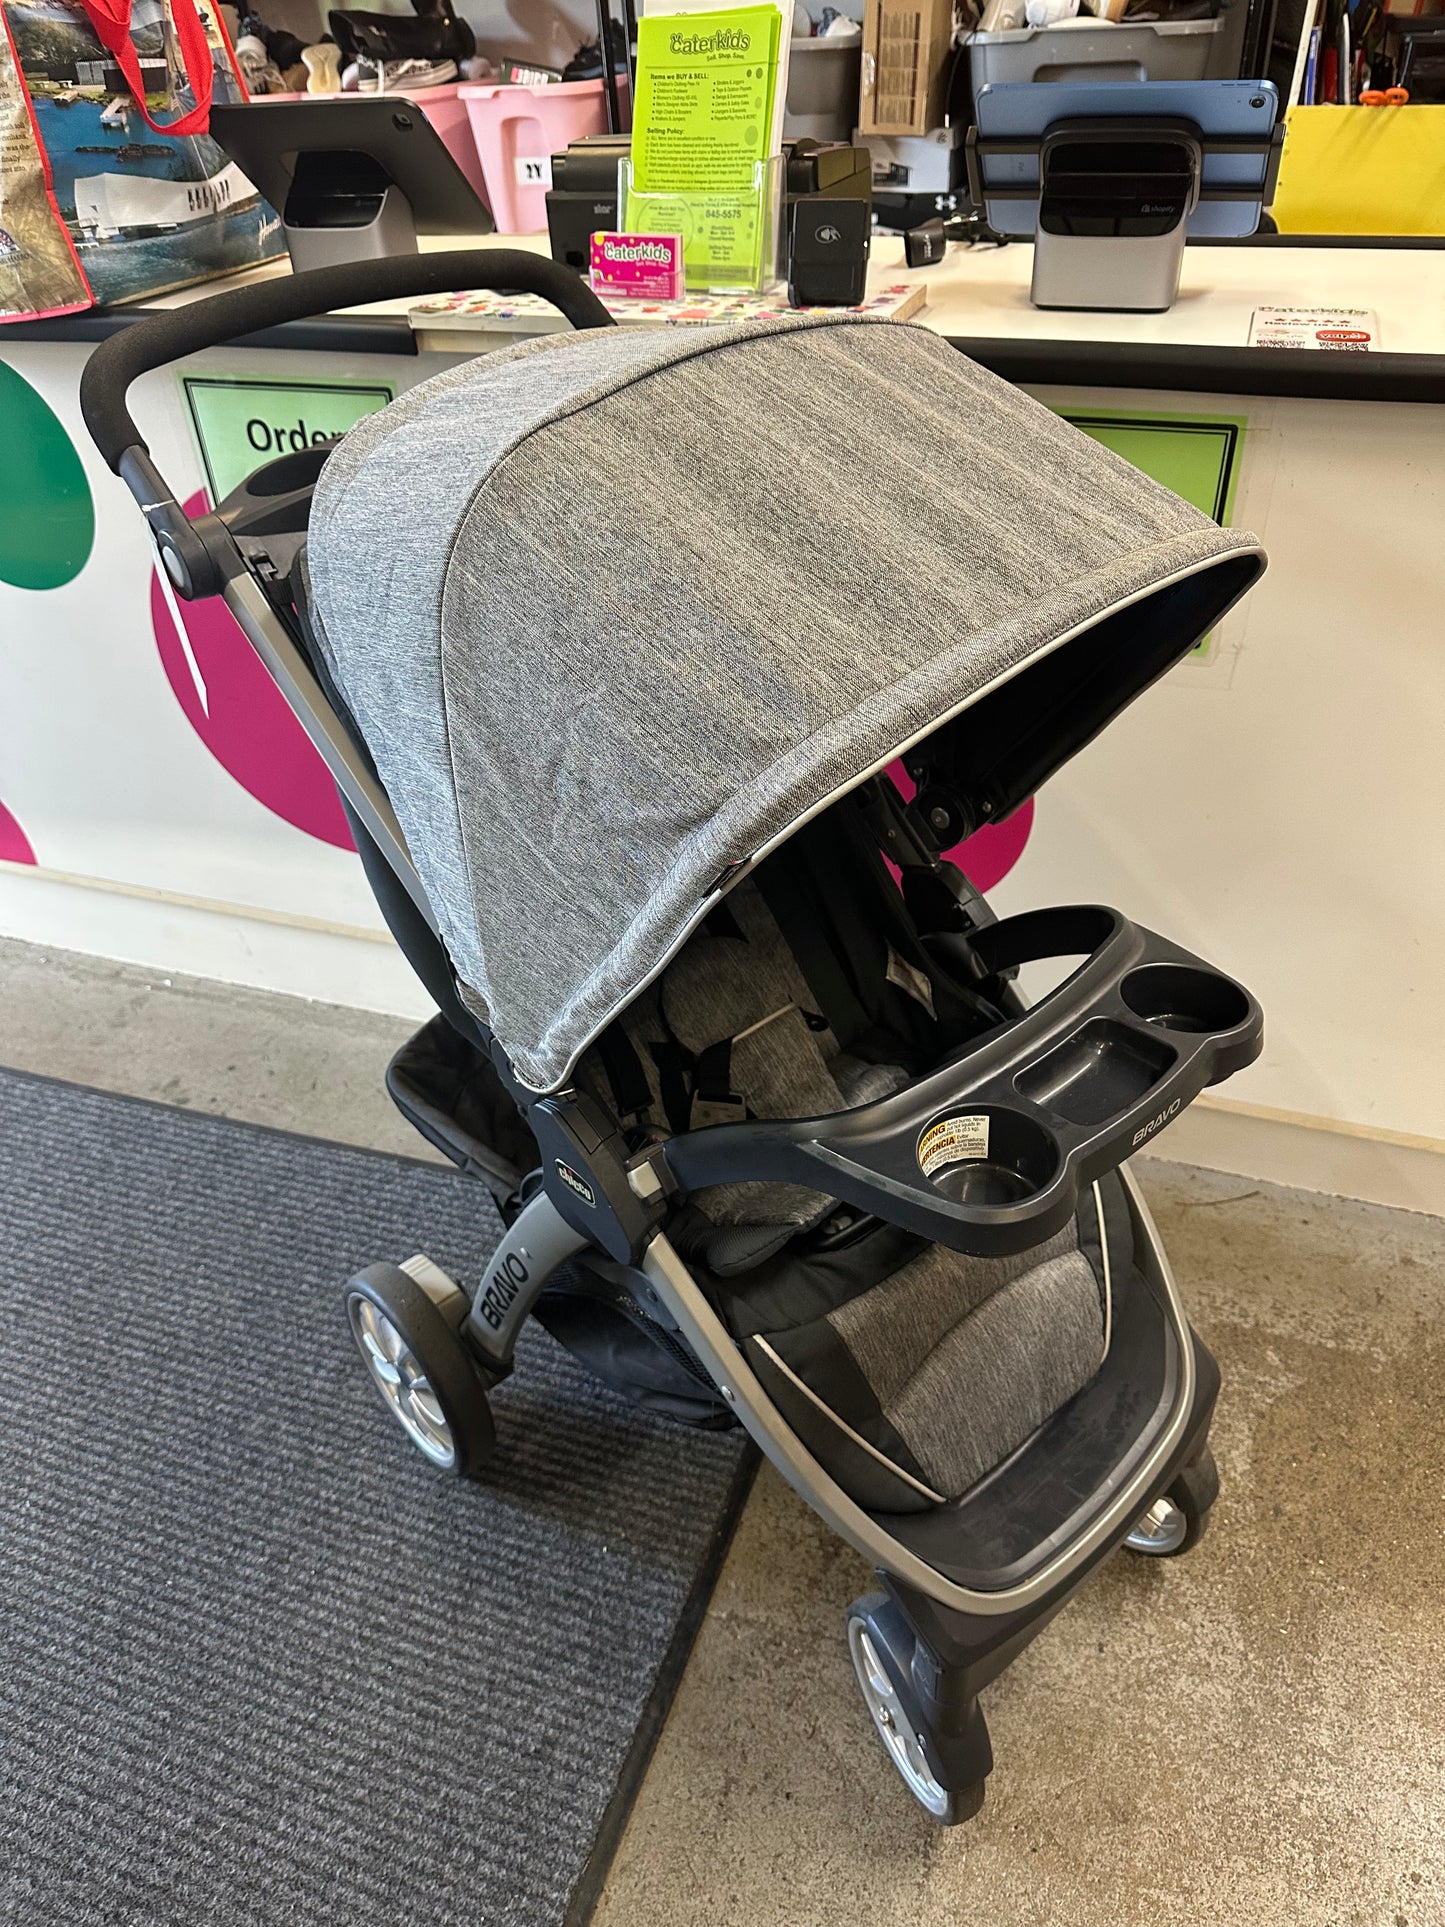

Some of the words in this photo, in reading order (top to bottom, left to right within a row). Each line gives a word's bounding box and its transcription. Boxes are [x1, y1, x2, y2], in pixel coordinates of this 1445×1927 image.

[670, 28, 751, 55] Caterkids
[646, 127, 666, 135] Selling
[604, 241, 672, 263] Caterkids
[246, 418, 344, 453] Orde
[1132, 1098, 1181, 1146] BRAVO
[558, 1167, 592, 1200] chicco
[480, 1252, 529, 1331] BRAVO
